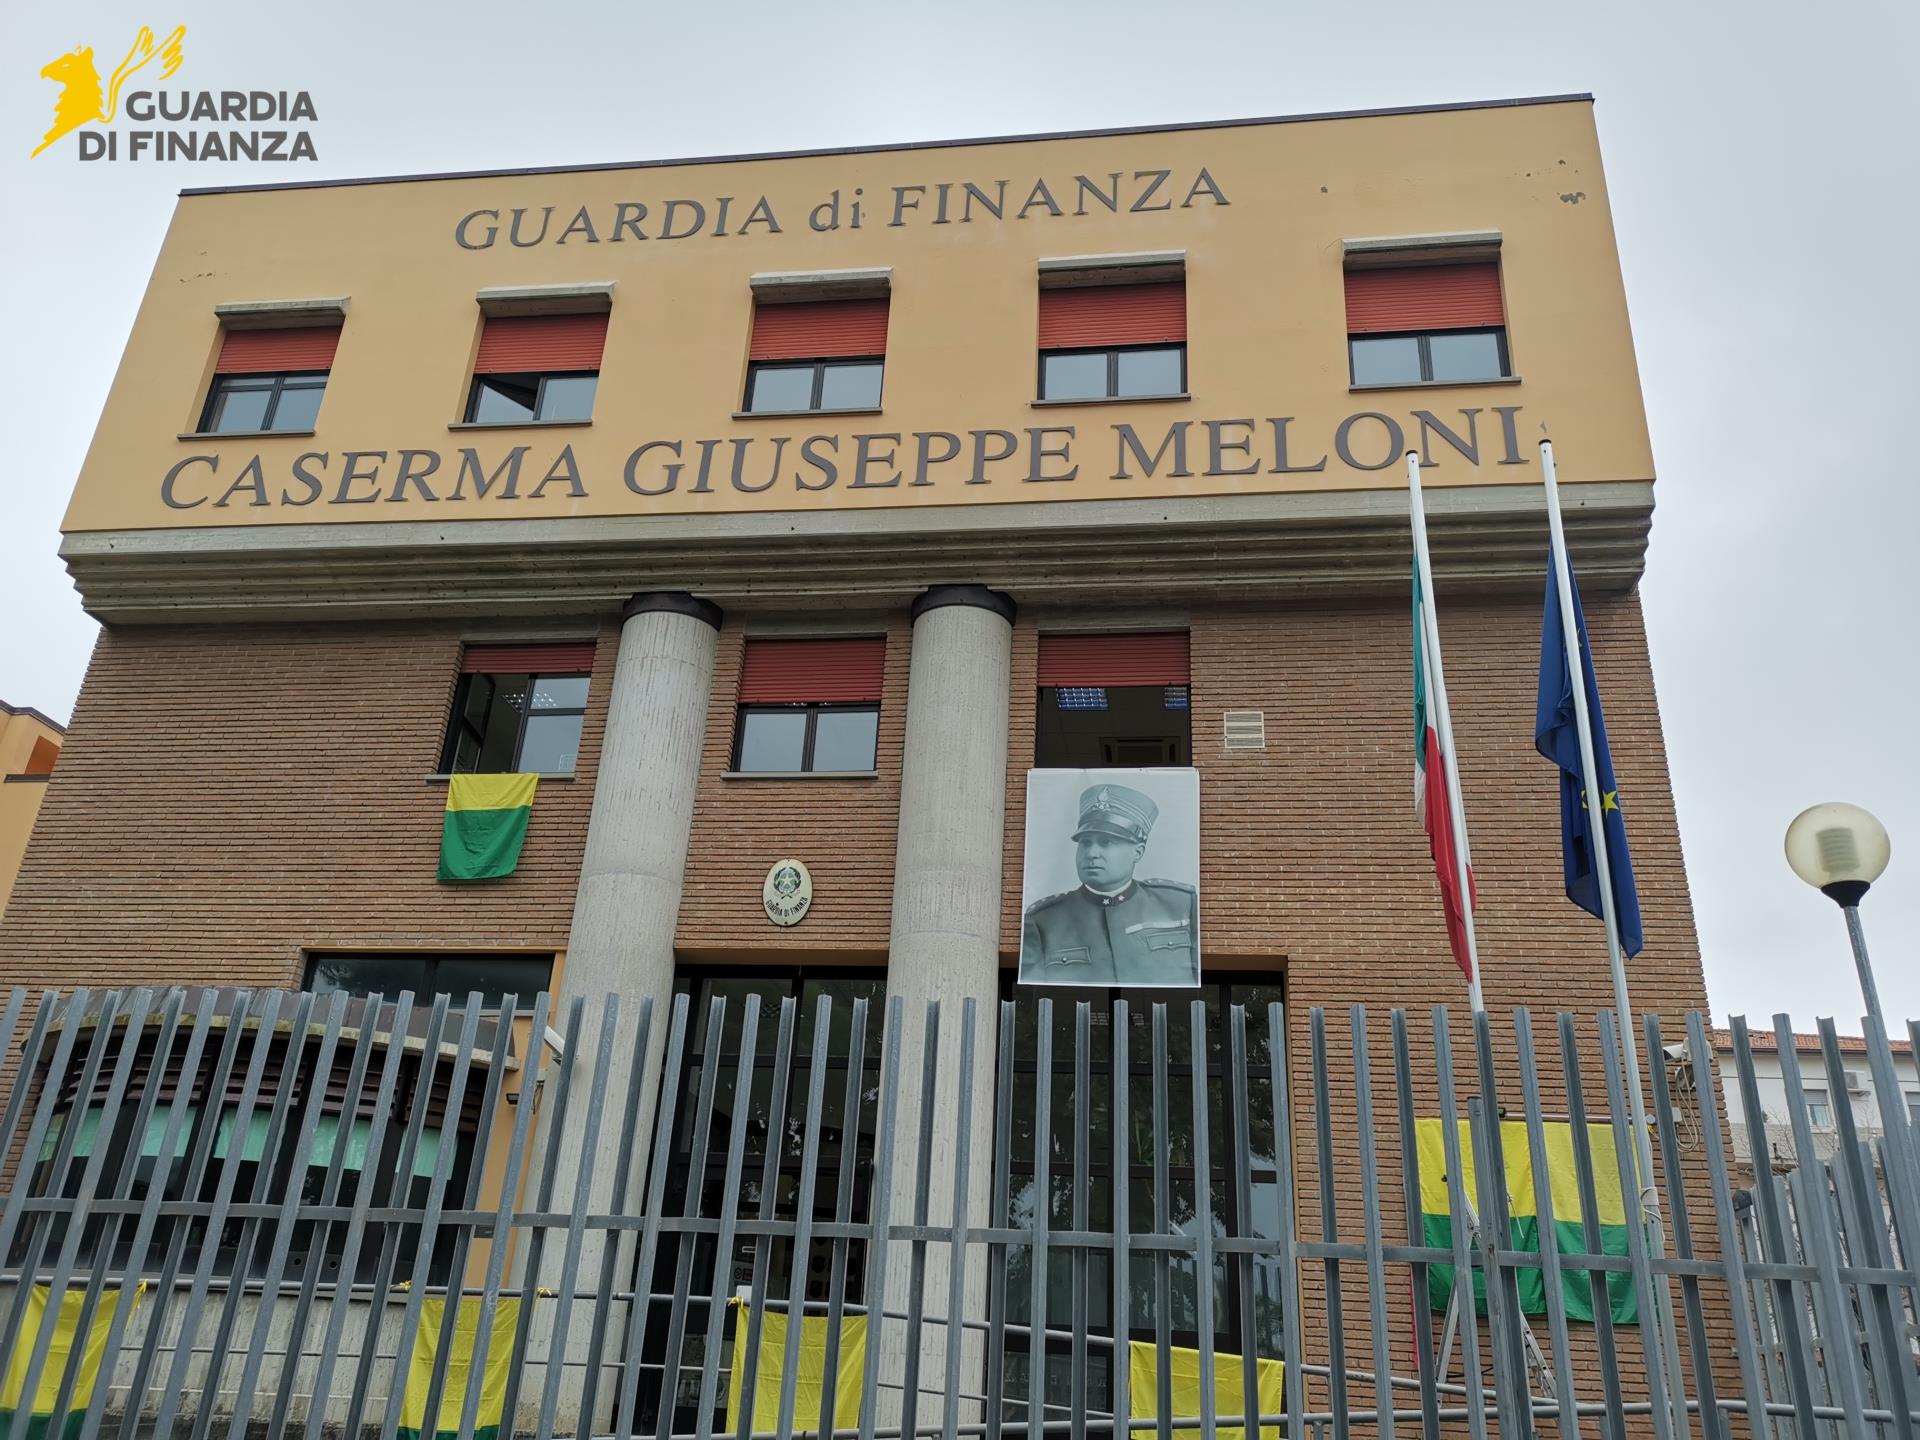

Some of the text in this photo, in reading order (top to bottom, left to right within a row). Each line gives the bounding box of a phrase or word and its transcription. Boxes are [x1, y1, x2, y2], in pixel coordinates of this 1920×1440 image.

[454, 167, 1232, 250] GUARDIA di FINANZA
[160, 406, 1530, 510] CASERMA GIUSEPPE MELONI
